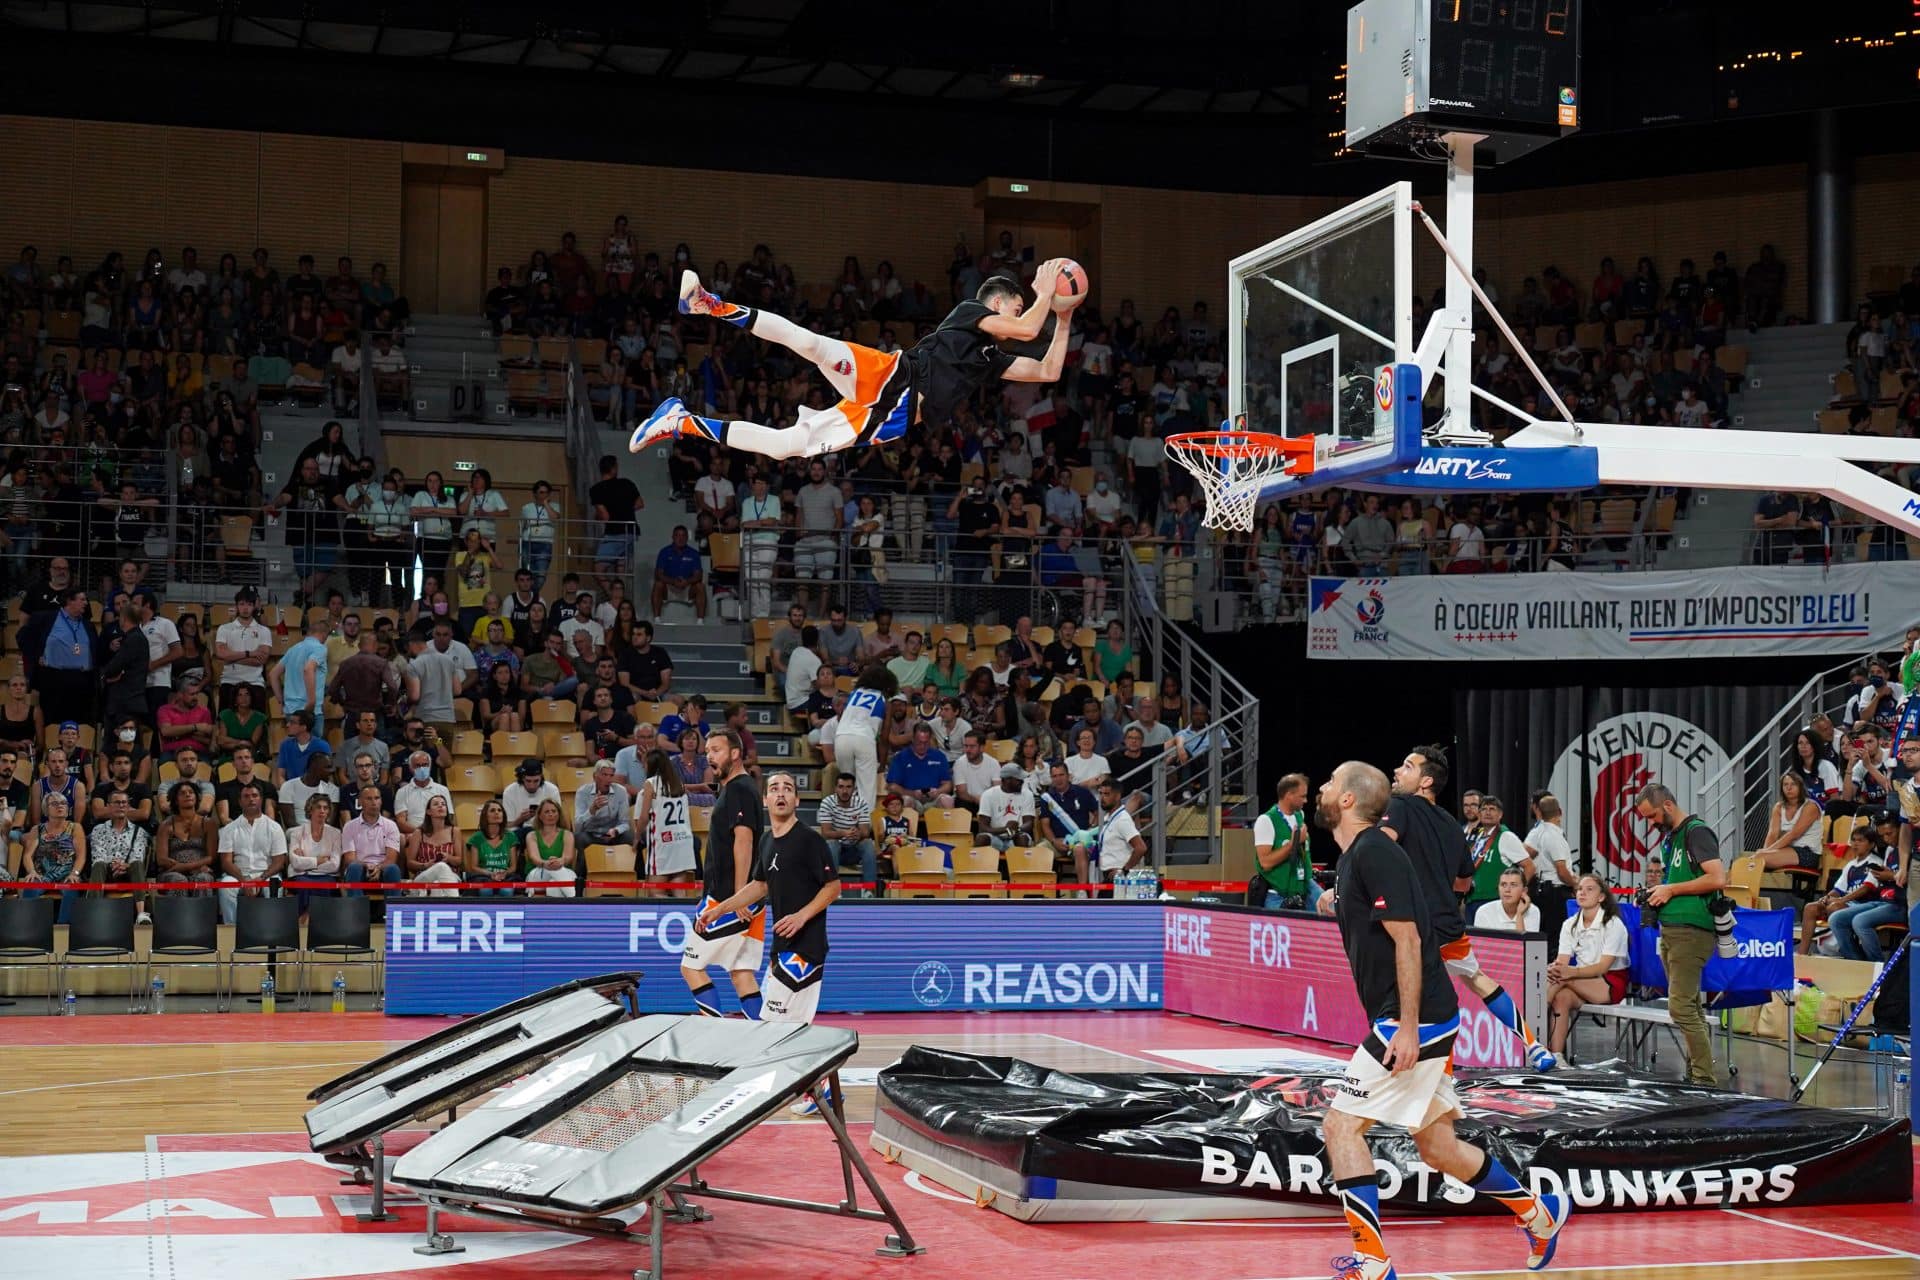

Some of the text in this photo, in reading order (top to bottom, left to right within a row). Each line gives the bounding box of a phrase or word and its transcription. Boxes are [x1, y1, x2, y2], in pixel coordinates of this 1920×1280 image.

[1353, 631, 1389, 641] FRANCE
[1435, 597, 1447, 631] À
[1454, 602, 1519, 631] COEUR
[1526, 600, 1623, 632] VAILLANT,
[1629, 599, 1677, 628] RIEN
[850, 690, 878, 710] 12
[1572, 721, 1713, 772] VENDÉE
[662, 799, 685, 826] 22
[392, 910, 694, 954] HERE FO
[1165, 912, 1292, 969] HERE FOR
[1736, 938, 1785, 959] olten
[963, 962, 1159, 1004] REASON.
[1302, 984, 1319, 1032] A
[1454, 1007, 1521, 1067] SON.
[1200, 1144, 1798, 1208] BAROTS DUNKERS
